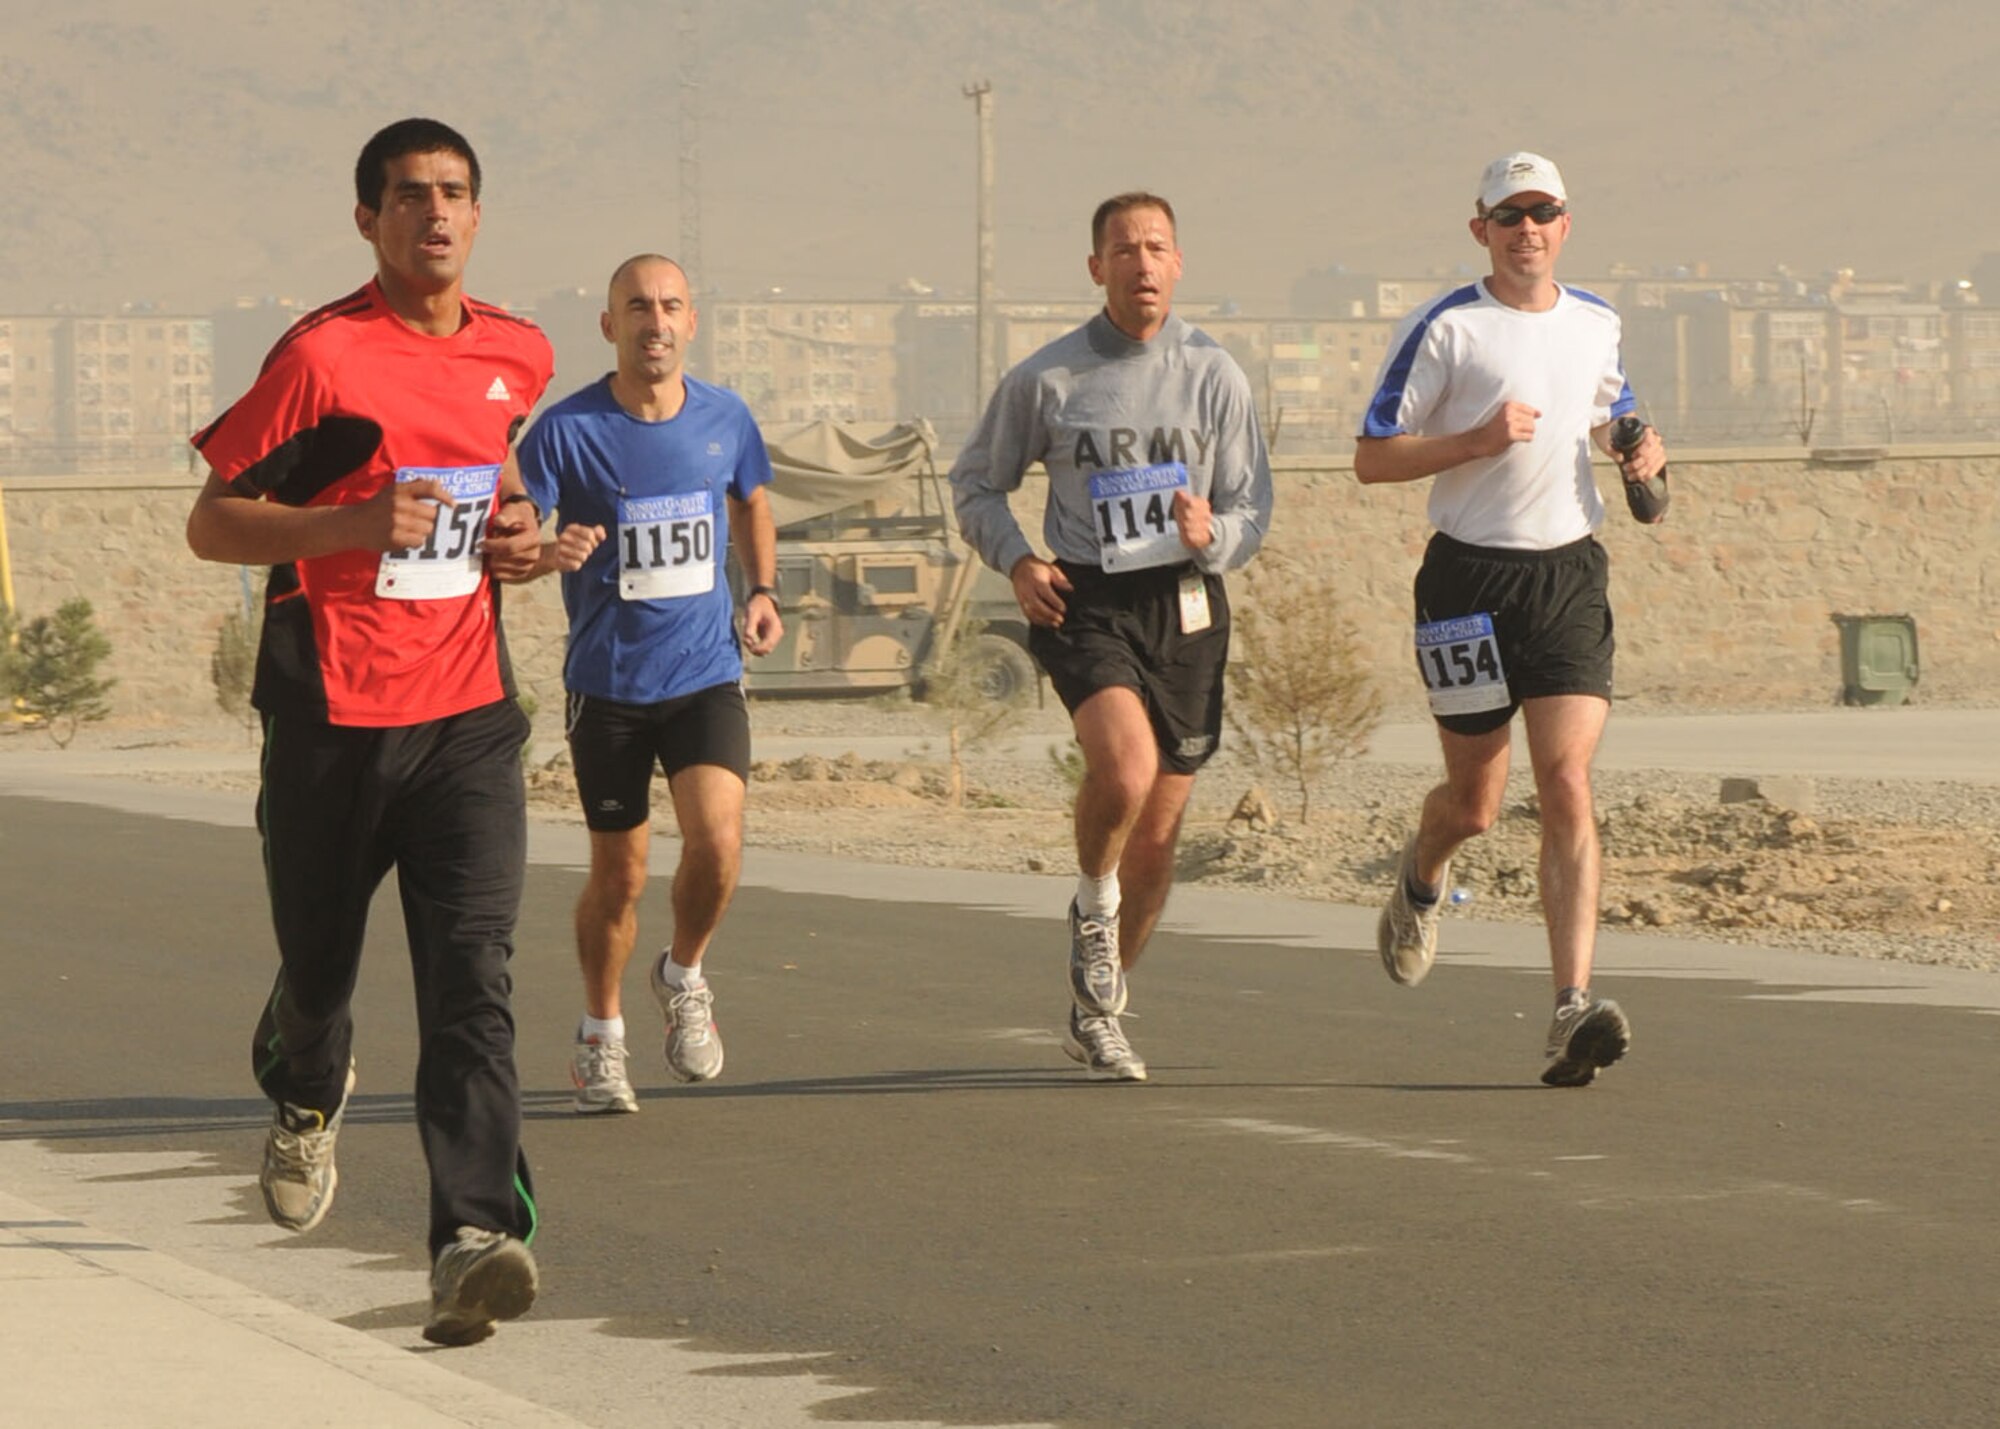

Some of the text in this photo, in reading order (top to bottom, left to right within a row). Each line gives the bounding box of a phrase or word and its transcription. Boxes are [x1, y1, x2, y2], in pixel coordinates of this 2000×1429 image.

[1074, 427, 1213, 468] ARMY
[389, 499, 491, 560] 157
[623, 519, 710, 569] 1150
